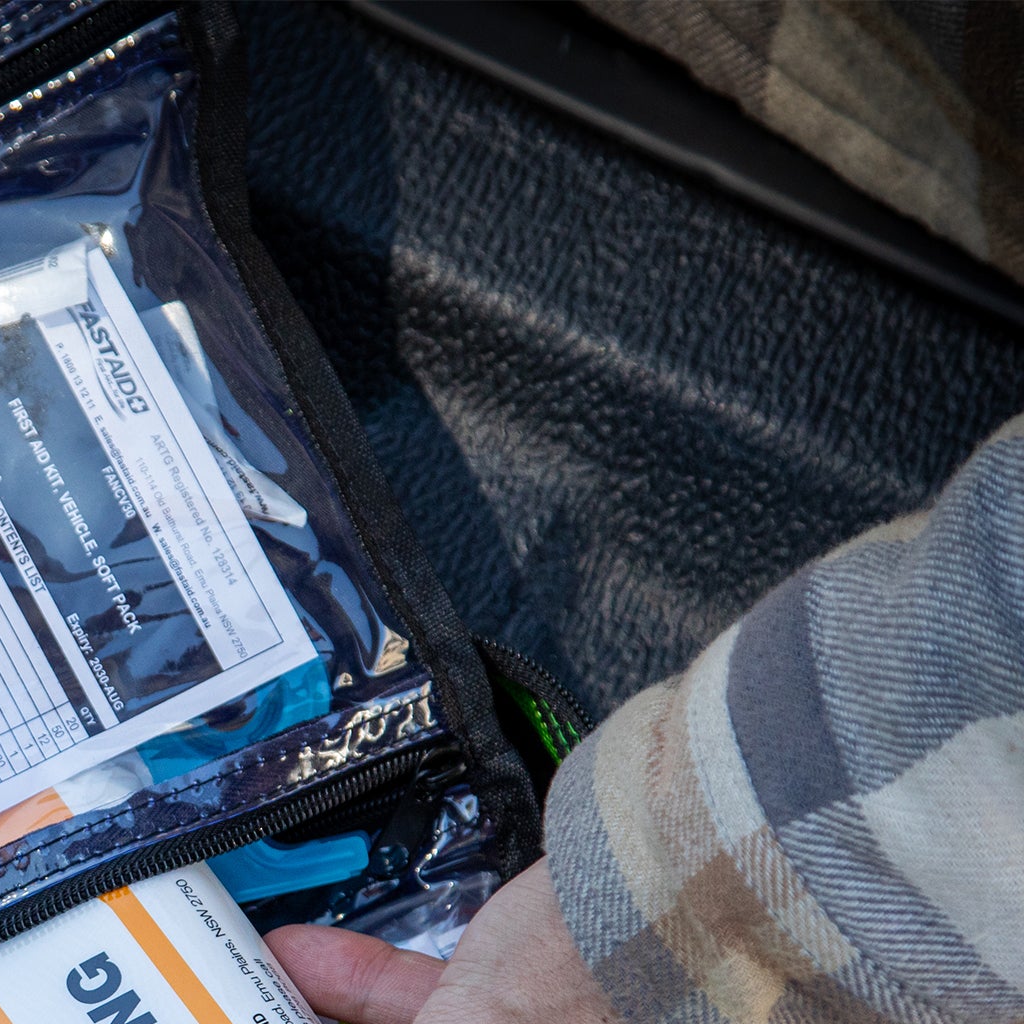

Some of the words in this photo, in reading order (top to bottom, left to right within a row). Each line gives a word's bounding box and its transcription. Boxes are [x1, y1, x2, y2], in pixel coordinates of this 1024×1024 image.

[73, 296, 141, 401] FASTAID
[6, 396, 37, 440] FIRST
[27, 437, 51, 465] AID
[39, 462, 66, 495] KIT,
[54, 490, 100, 558] VEHICLE,
[90, 554, 120, 595] SOFT
[110, 592, 142, 635] PACK
[99, 464, 137, 520] FANCV30
[149, 432, 174, 466] ARTG
[165, 465, 207, 528] Registered
[198, 525, 217, 547] No.
[210, 546, 238, 587] 128314
[96, 425, 154, 519] sales@fastaid.com.au
[156, 536, 213, 630] sales@fastaid.com.au
[151, 490, 167, 508] Old
[160, 506, 186, 543] Bathurst
[192, 568, 210, 589] Emu
[203, 587, 223, 615] Plains
[22, 564, 46, 595] LIST
[62, 612, 95, 657] Expiry:
[87, 655, 125, 712] 2030-AUG
[77, 704, 96, 727] QTY
[174, 875, 203, 908] 2750
[195, 904, 227, 940] NSW
[220, 935, 257, 978] Plains,
[248, 974, 276, 1005] Emu
